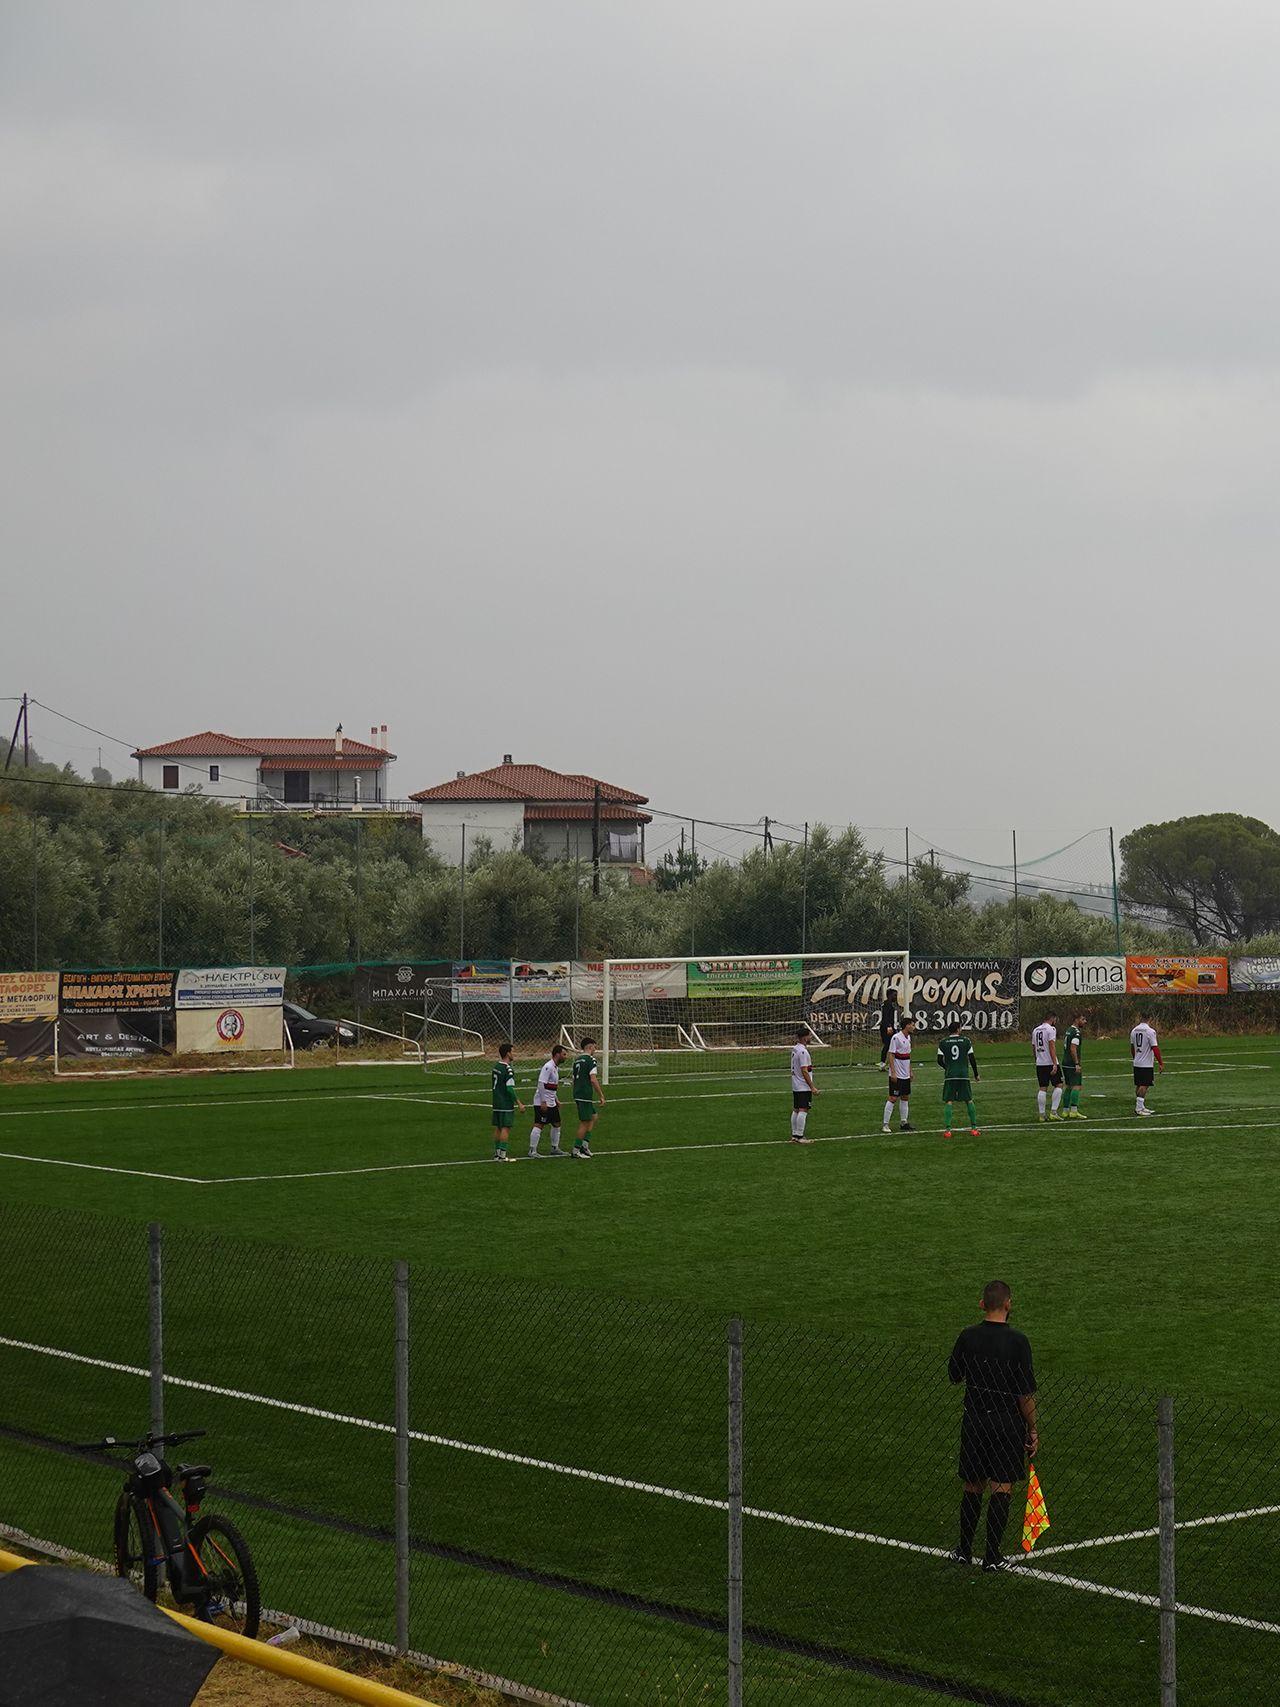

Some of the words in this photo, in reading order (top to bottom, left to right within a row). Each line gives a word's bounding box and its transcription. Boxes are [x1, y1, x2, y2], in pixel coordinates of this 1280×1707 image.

[941, 961, 1000, 970] ΜΙΚΡΟΓΕΥΜΑΤΑ
[1247, 963, 1263, 974] ice
[19, 974, 56, 983] ΟΔΙΚΕΣ
[1024, 960, 1123, 992] Optima
[1081, 983, 1124, 992] Thessalias
[7, 994, 56, 1003] ΜΕΤΑΦΟΡΙΚΗ
[810, 1012, 868, 1023] DELIVERY
[951, 1044, 960, 1060] 9
